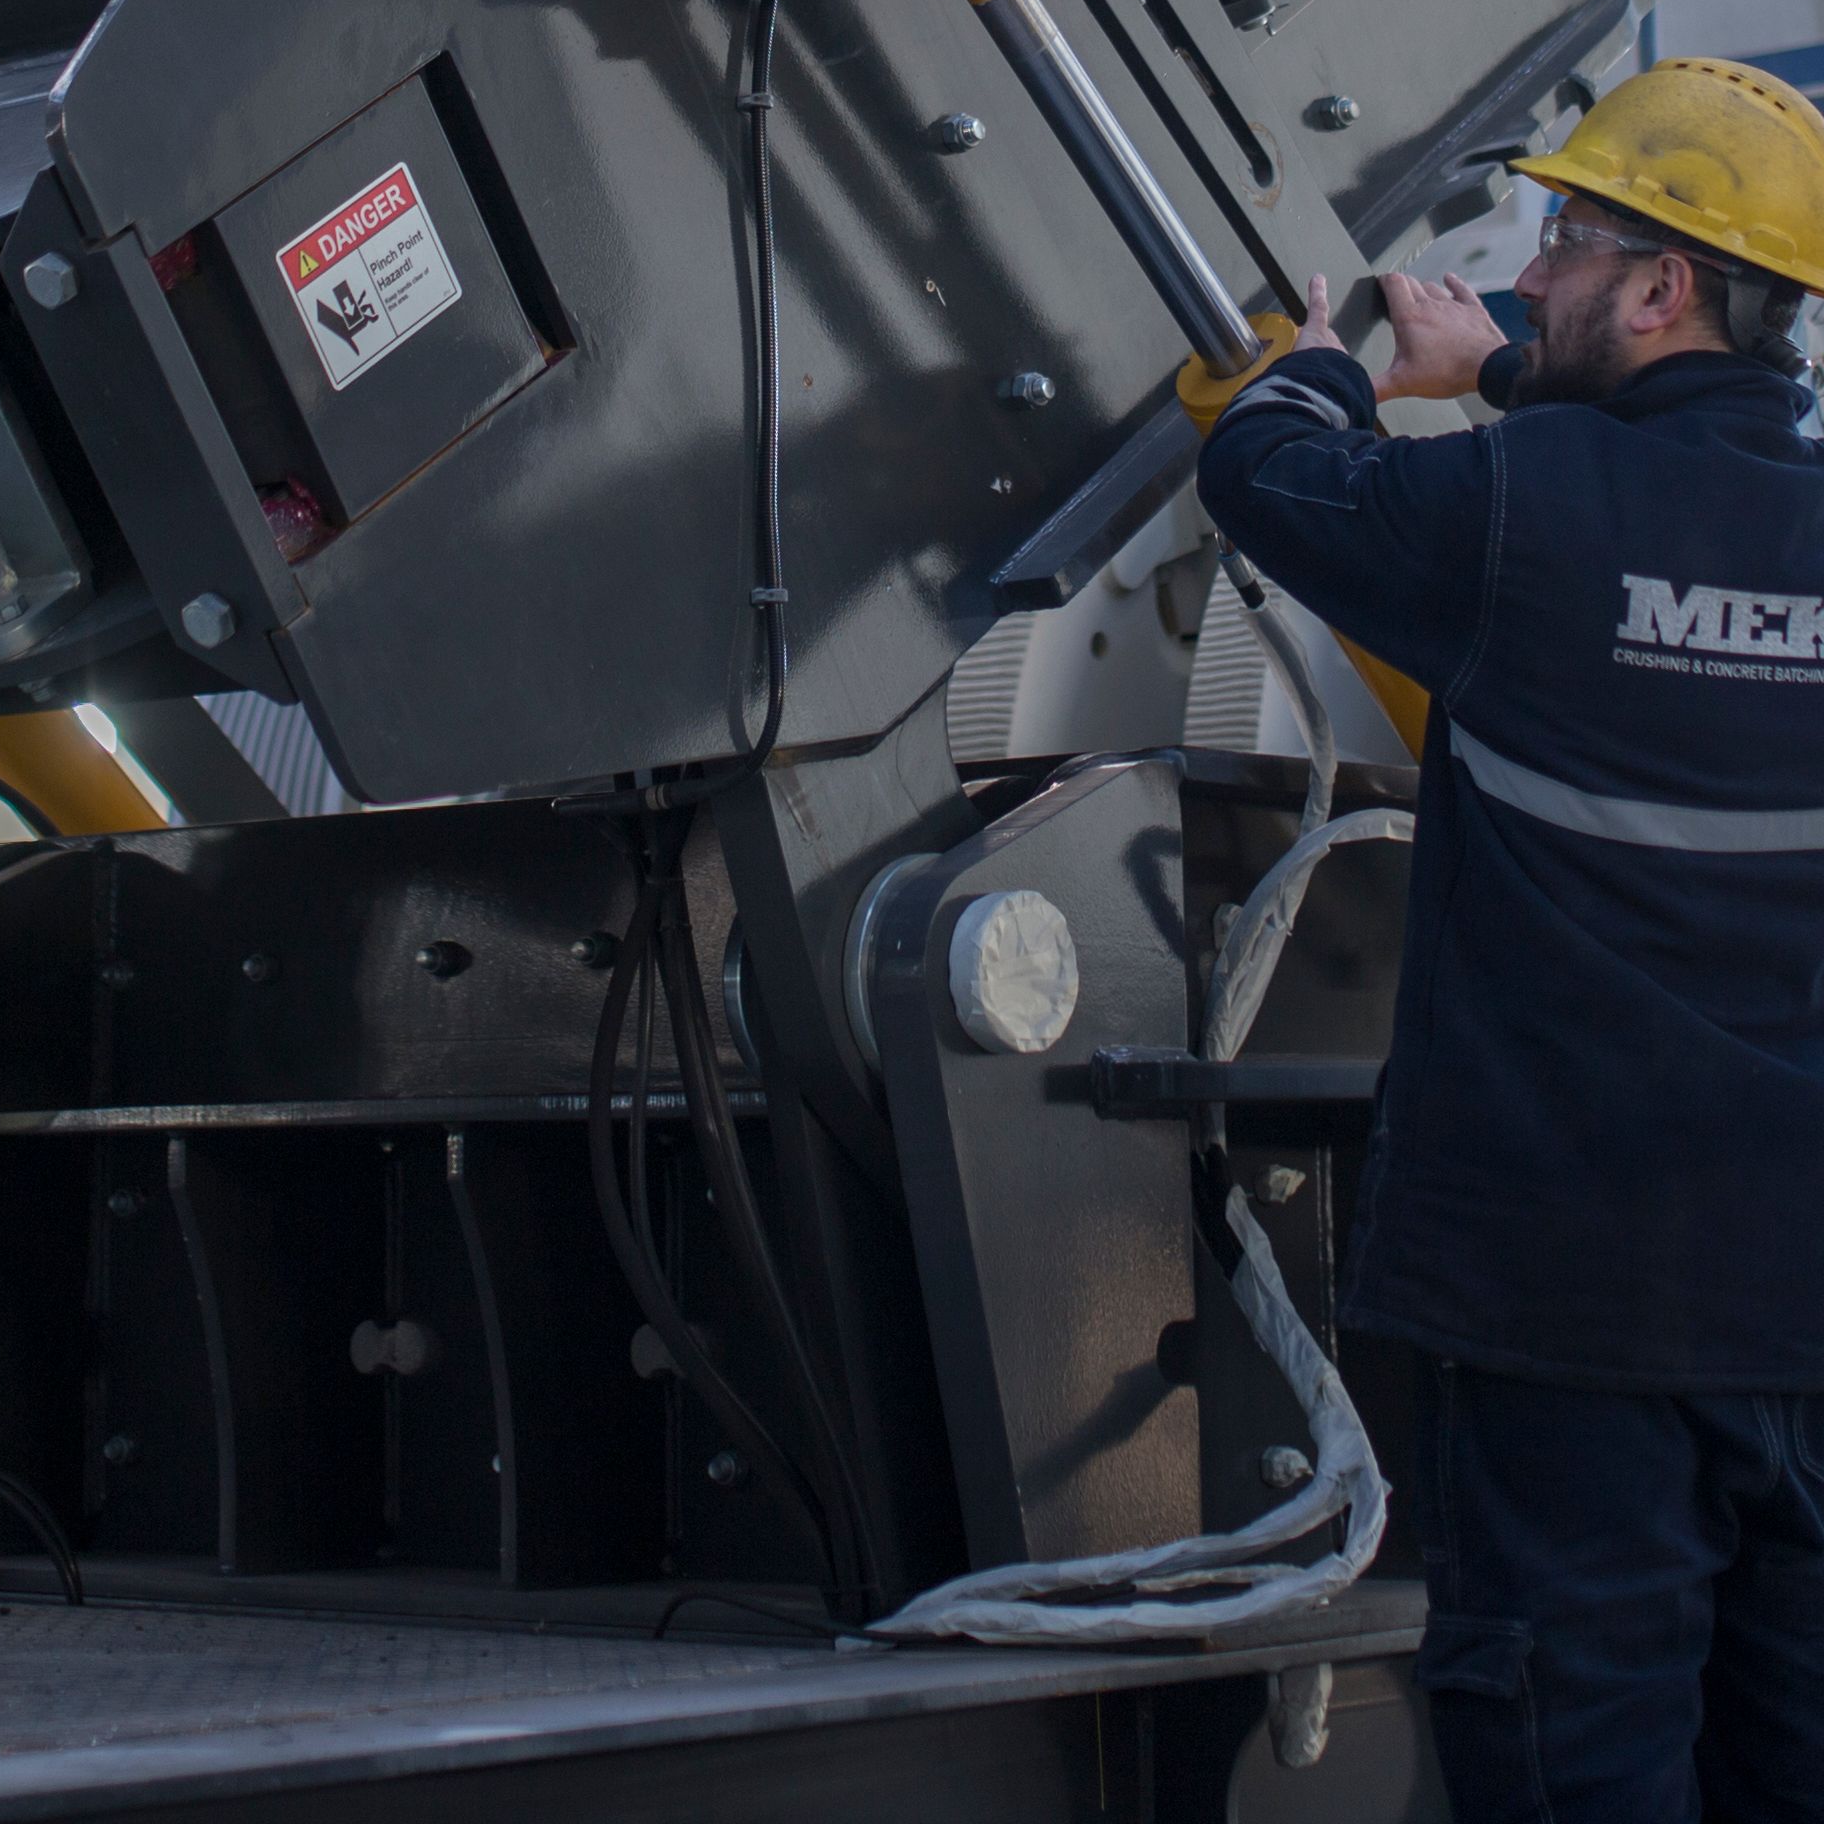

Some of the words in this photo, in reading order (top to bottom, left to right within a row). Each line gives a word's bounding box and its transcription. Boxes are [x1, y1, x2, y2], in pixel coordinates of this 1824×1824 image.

[317, 184, 406, 261] DANGER
[370, 249, 398, 275] Pinch
[397, 230, 424, 255] Point
[377, 257, 413, 291] Hazard!
[1612, 646, 1690, 673] CRUSHING
[1692, 657, 1704, 675] &
[1705, 659, 1772, 681] CONCRETE
